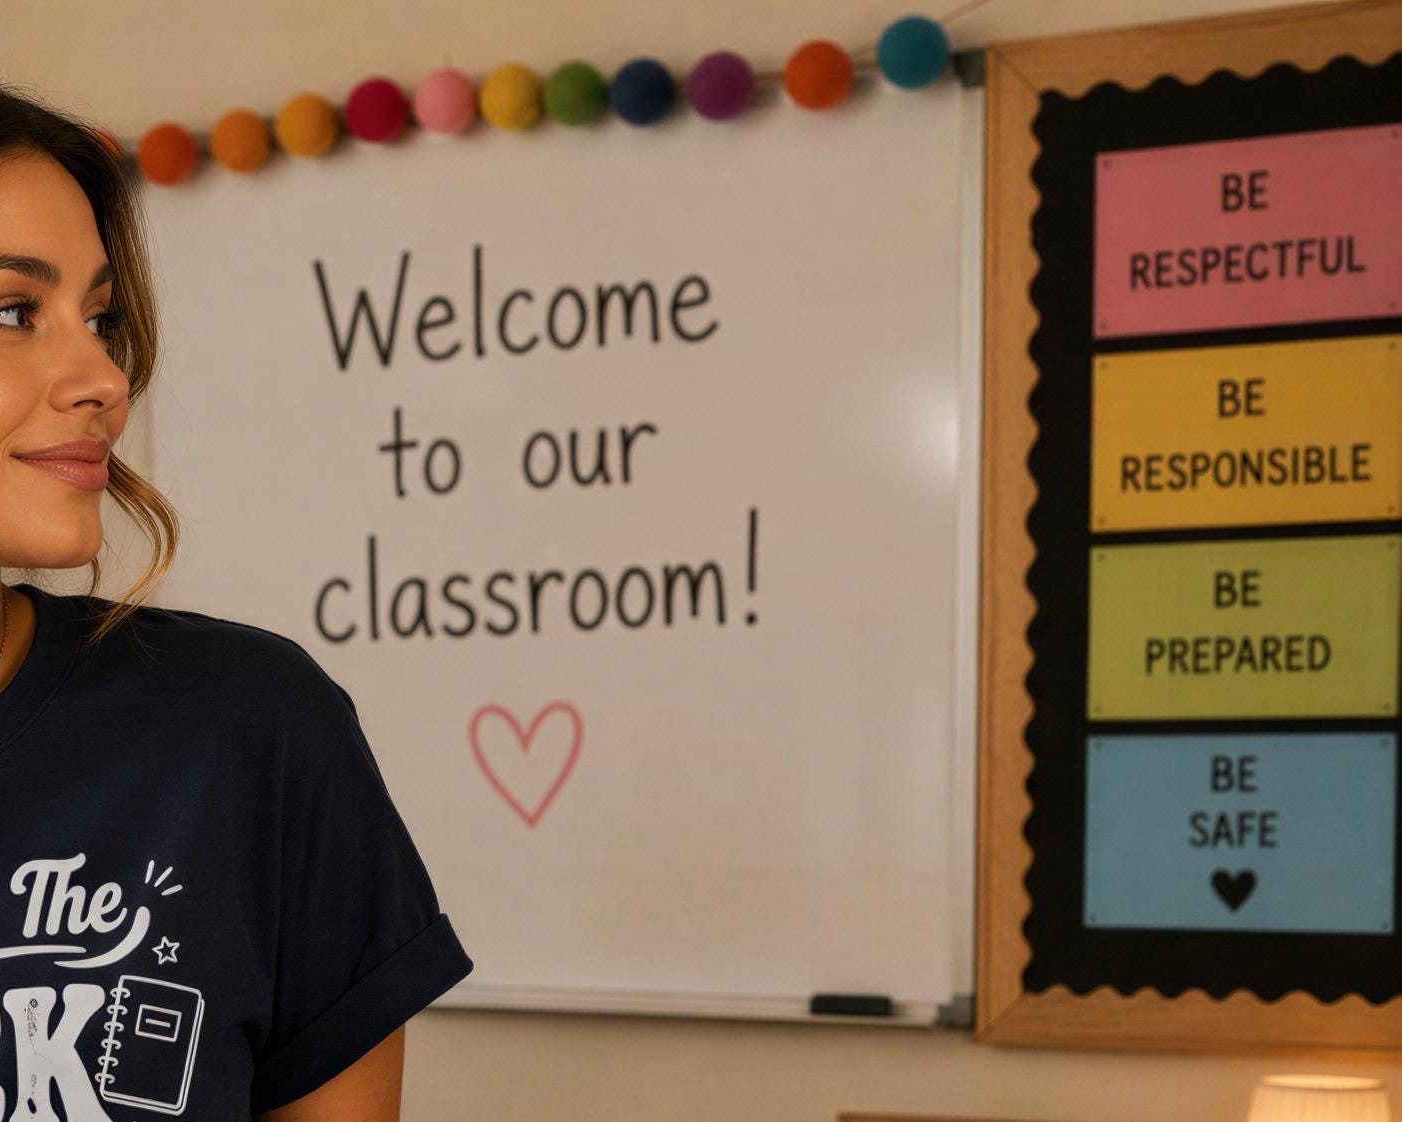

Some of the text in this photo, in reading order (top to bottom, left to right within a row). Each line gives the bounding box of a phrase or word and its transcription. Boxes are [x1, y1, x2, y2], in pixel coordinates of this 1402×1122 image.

[1221, 170, 1270, 213] BE
[1130, 235, 1367, 290] RESPECTFUL
[312, 242, 720, 372] Welcome
[1217, 377, 1267, 419] BE
[378, 405, 658, 498] to our
[1120, 443, 1373, 494] RESPONSIBLE
[314, 505, 760, 644] classroom!
[1213, 570, 1262, 609] BE
[1145, 634, 1332, 676] PREPARED
[1210, 755, 1258, 794] BE
[1188, 810, 1278, 849] SAFE
[9, 852, 131, 942] The
